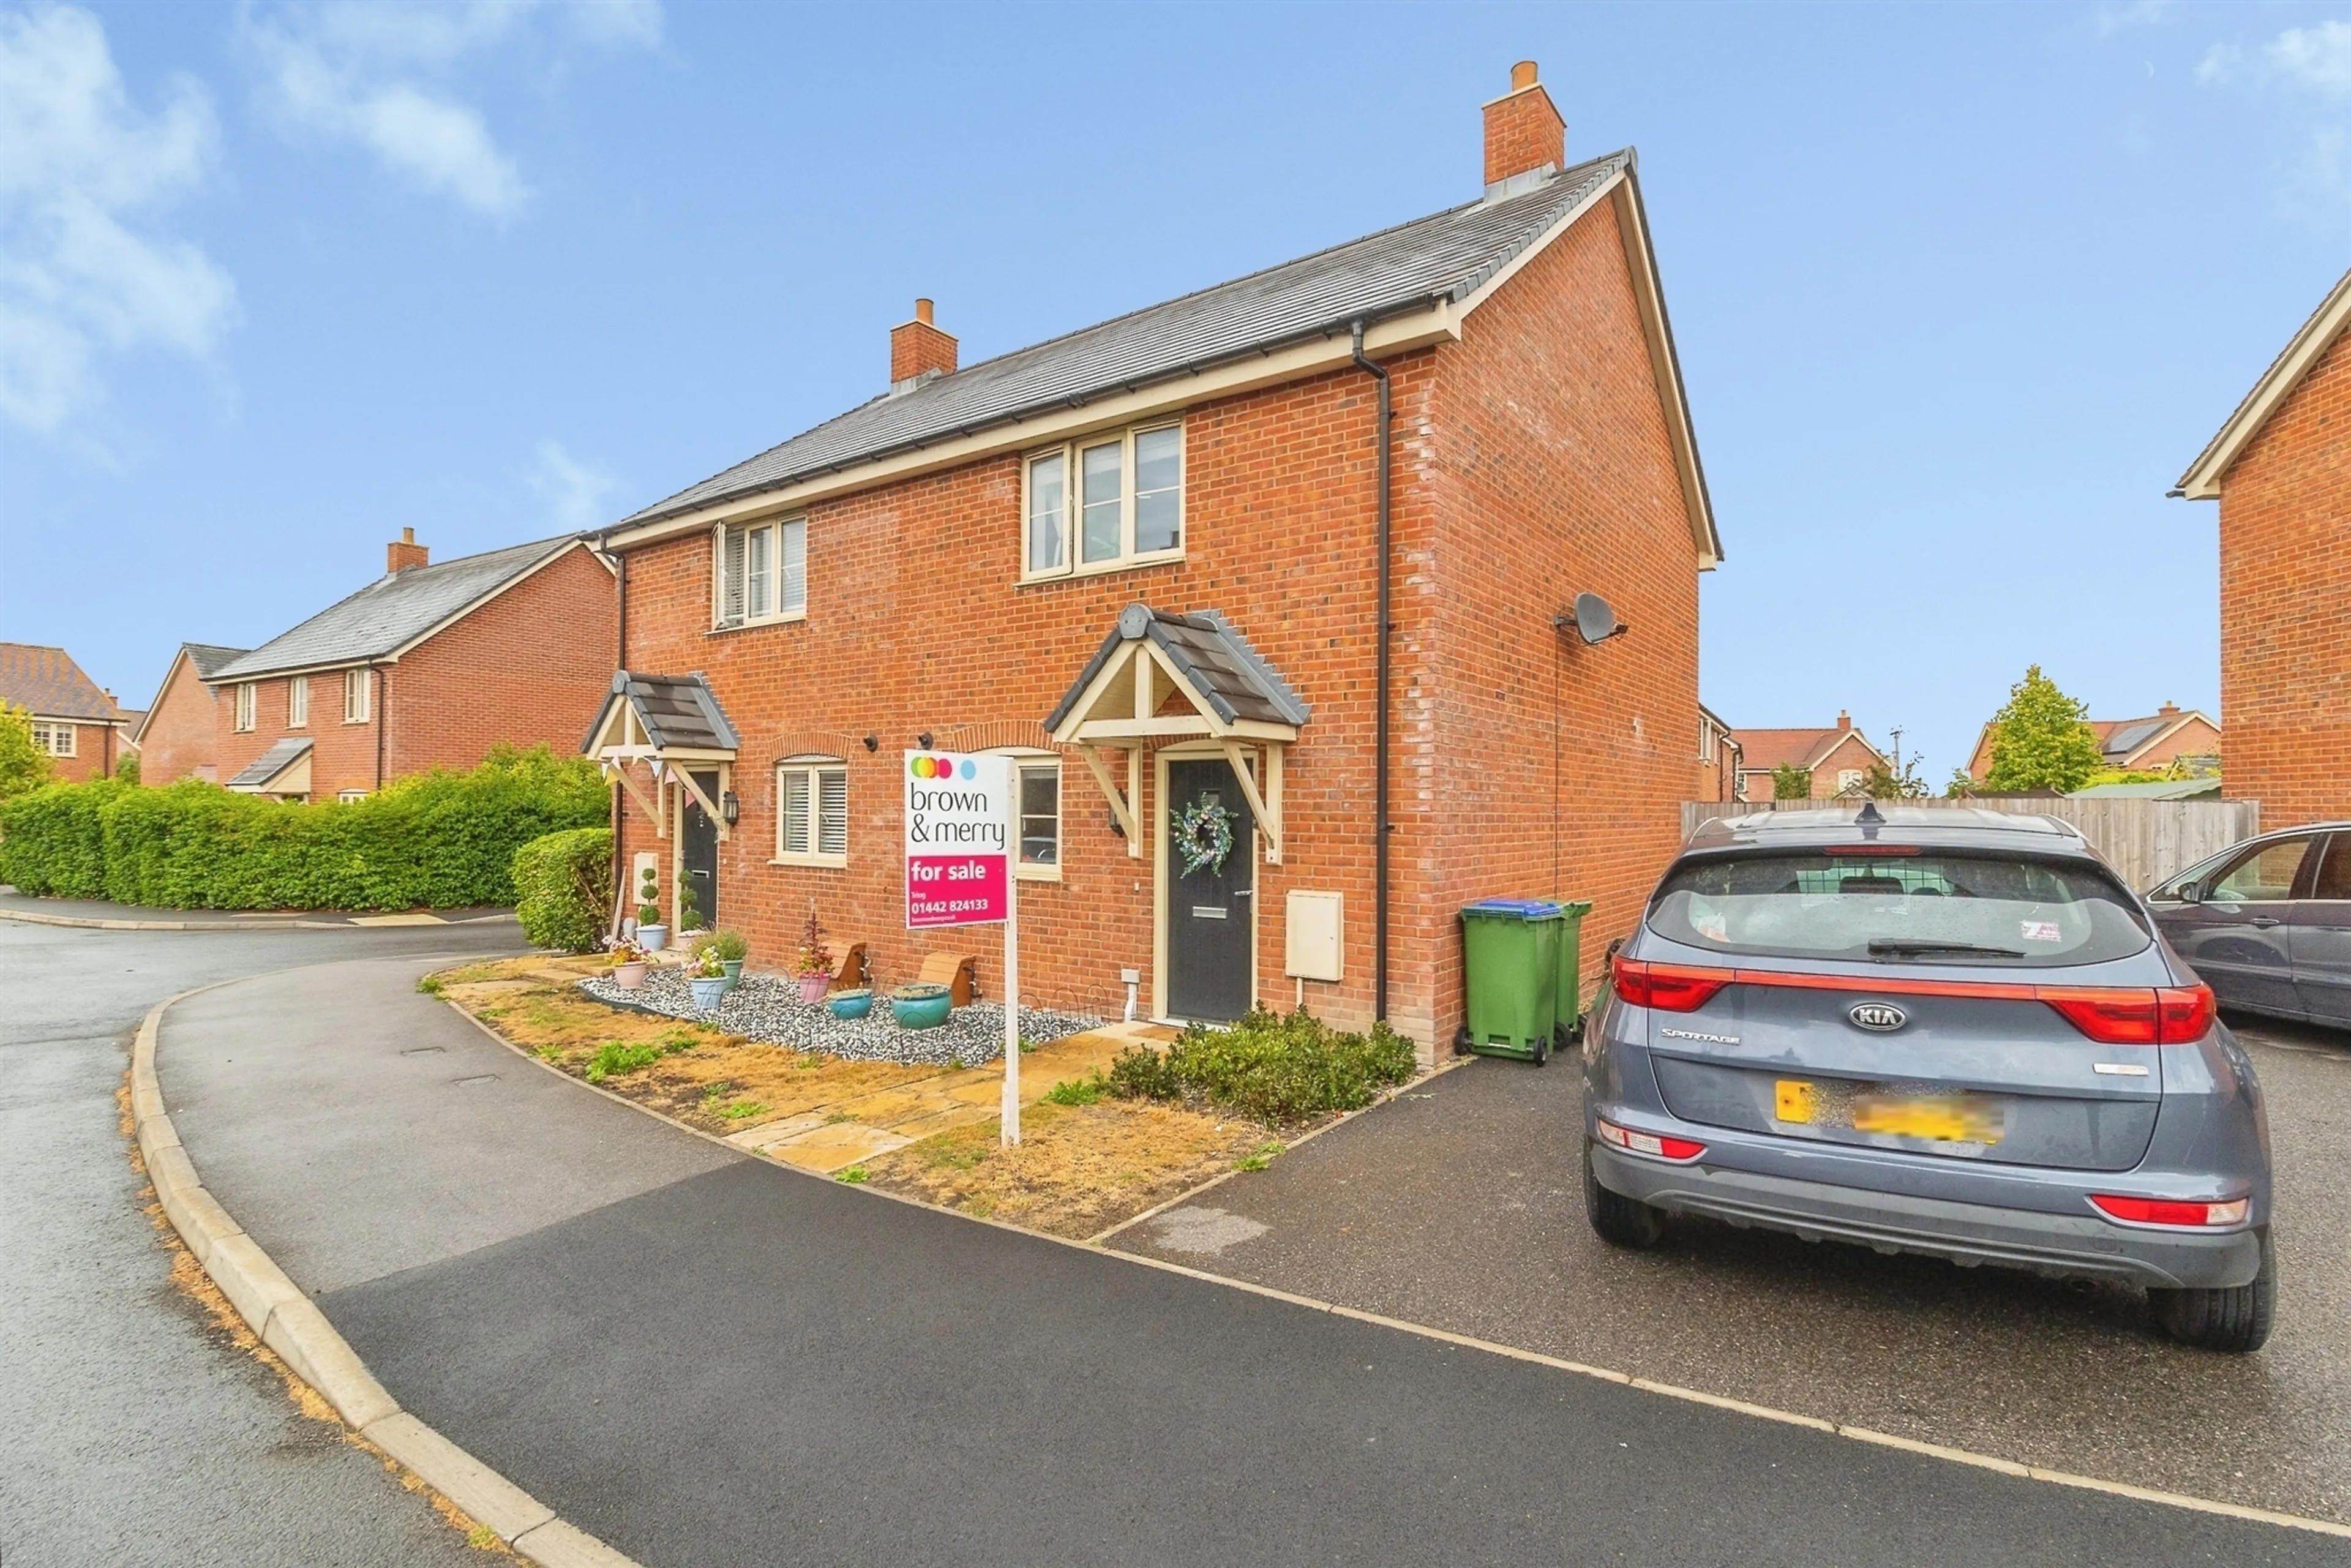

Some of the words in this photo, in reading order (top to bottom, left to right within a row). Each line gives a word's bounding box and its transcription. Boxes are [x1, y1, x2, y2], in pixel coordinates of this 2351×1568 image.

[910, 782, 988, 812] brown
[911, 813, 929, 842] &
[935, 822, 1005, 850] merry
[911, 860, 943, 882] for
[948, 860, 986, 880] sale
[911, 901, 947, 915] 01442
[949, 898, 988, 912] 824133
[1859, 1008, 1897, 1024] KIA
[1661, 1028, 1741, 1046] SPORTAGE
